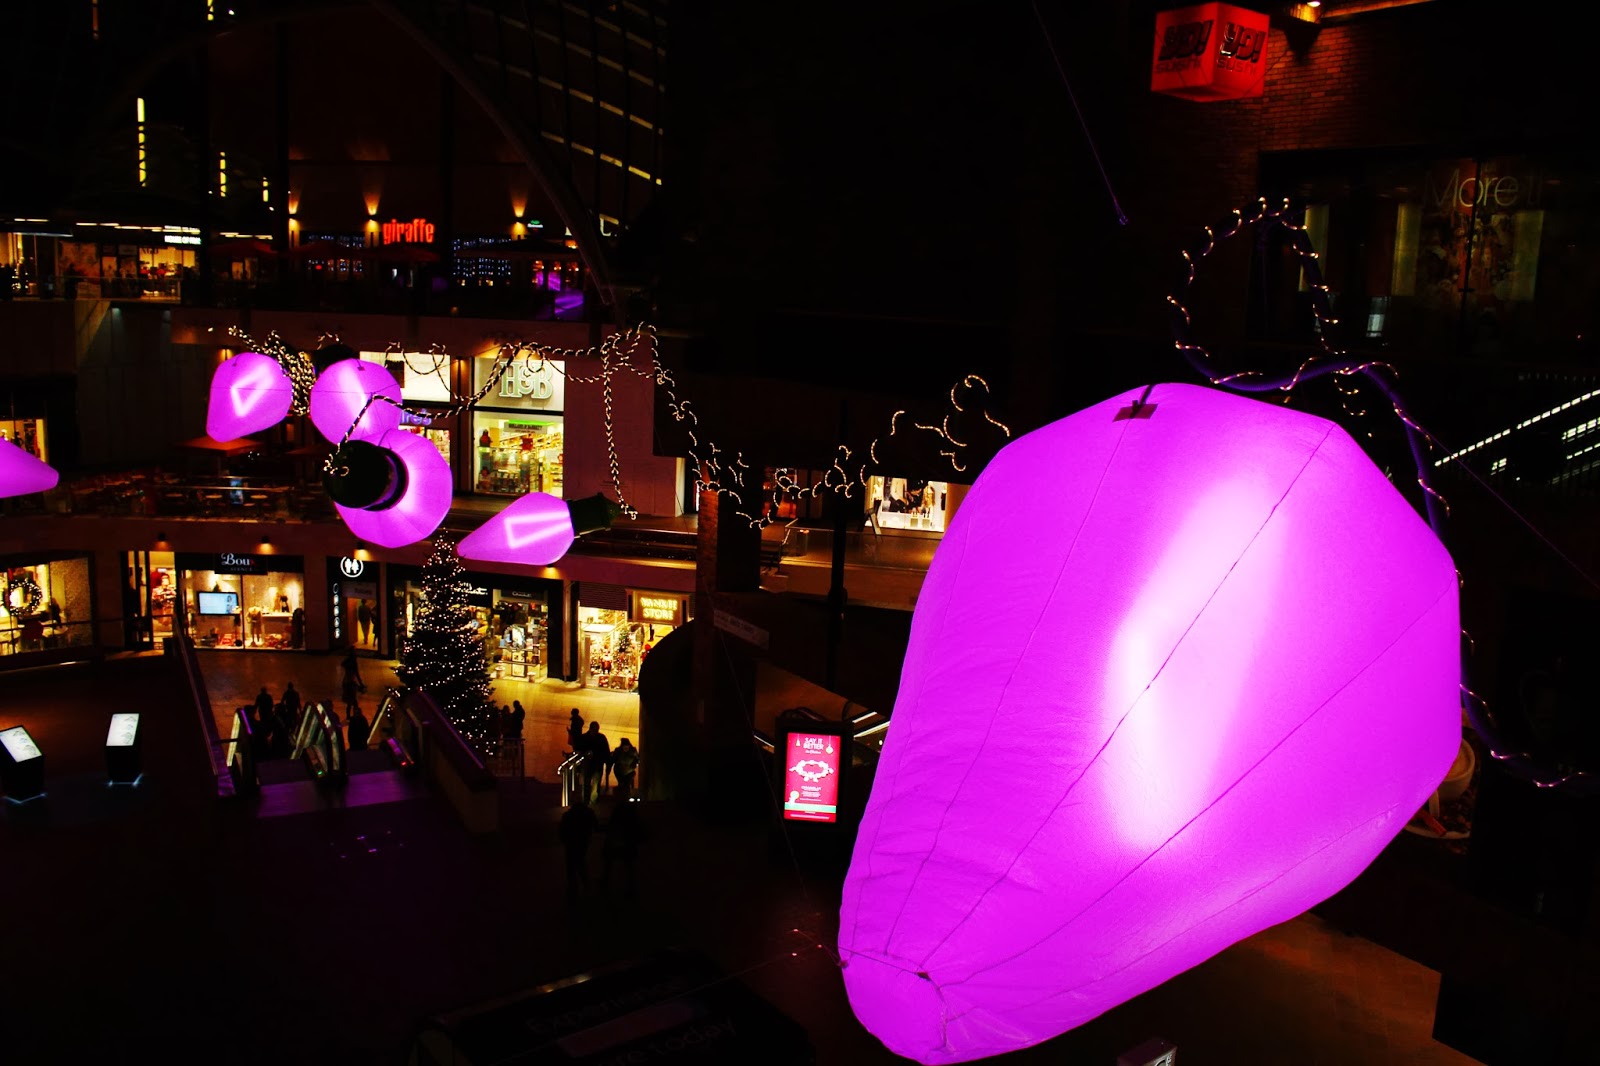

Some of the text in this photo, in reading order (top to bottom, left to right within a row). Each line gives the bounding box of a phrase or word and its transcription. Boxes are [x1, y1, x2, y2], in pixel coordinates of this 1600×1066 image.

[1220, 22, 1267, 63] YO!
[1423, 168, 1519, 208] More
[382, 218, 435, 246] giraffe
[643, 608, 674, 620] STORE
